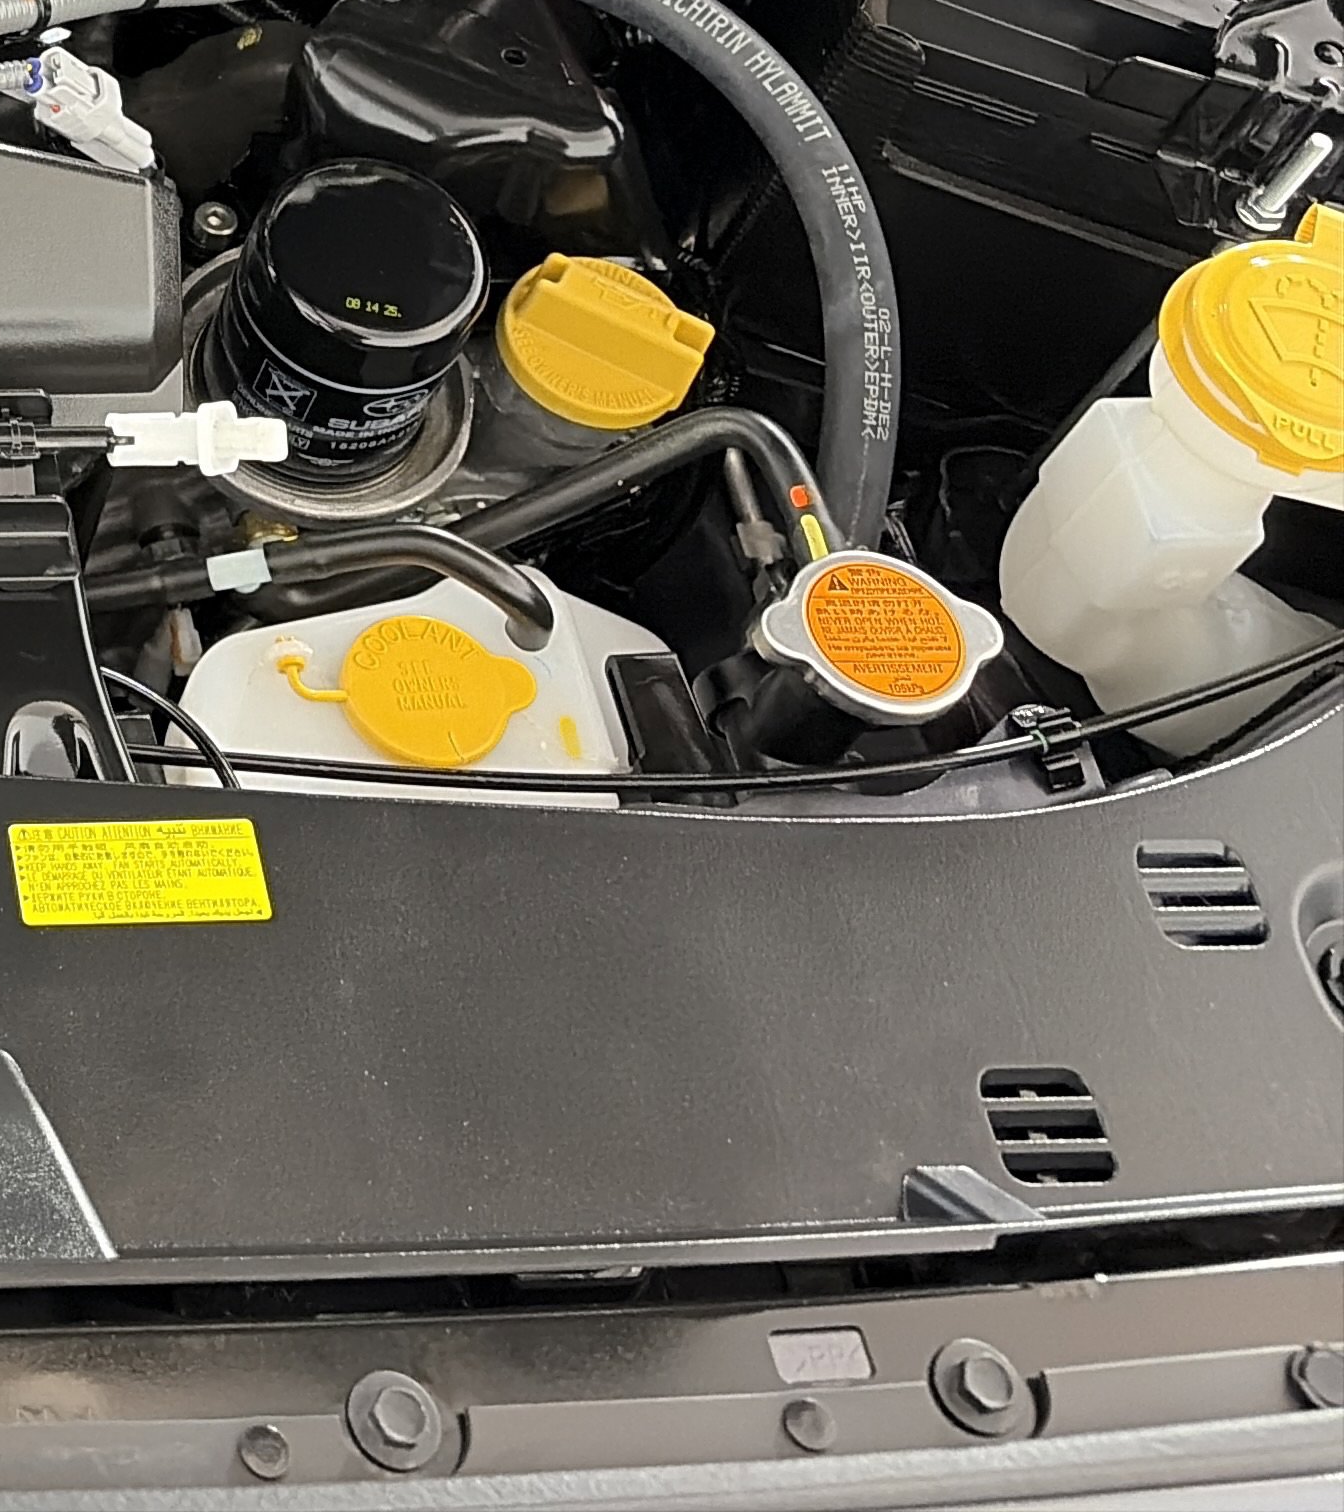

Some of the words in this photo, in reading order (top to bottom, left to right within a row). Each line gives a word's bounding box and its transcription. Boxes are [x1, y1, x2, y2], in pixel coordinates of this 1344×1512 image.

[345, 296, 361, 311] 08
[365, 300, 379, 315] 14
[593, 388, 655, 409] MANUAL
[313, 425, 355, 438] MADE
[1272, 413, 1336, 450] PULL
[848, 577, 907, 587] WARNING
[817, 616, 850, 626] NEVER
[854, 616, 883, 626] OPEN
[885, 617, 918, 627] WHEN
[353, 619, 480, 671] COOLANT
[852, 663, 945, 675] AVERTISSEMENT
[397, 693, 467, 712] MANUAL
[56, 826, 97, 840] CAUTION
[102, 824, 151, 840] ATTENTION
[25, 863, 46, 871] KEEP
[52, 862, 77, 871] HANDS
[113, 860, 129, 869] FAN
[135, 859, 166, 869] STARTS
[108, 868, 163, 879] VENTILATEUR
[56, 881, 105, 891] APPROCHEZ
[110, 880, 128, 889] PAS
[133, 879, 150, 889] LES
